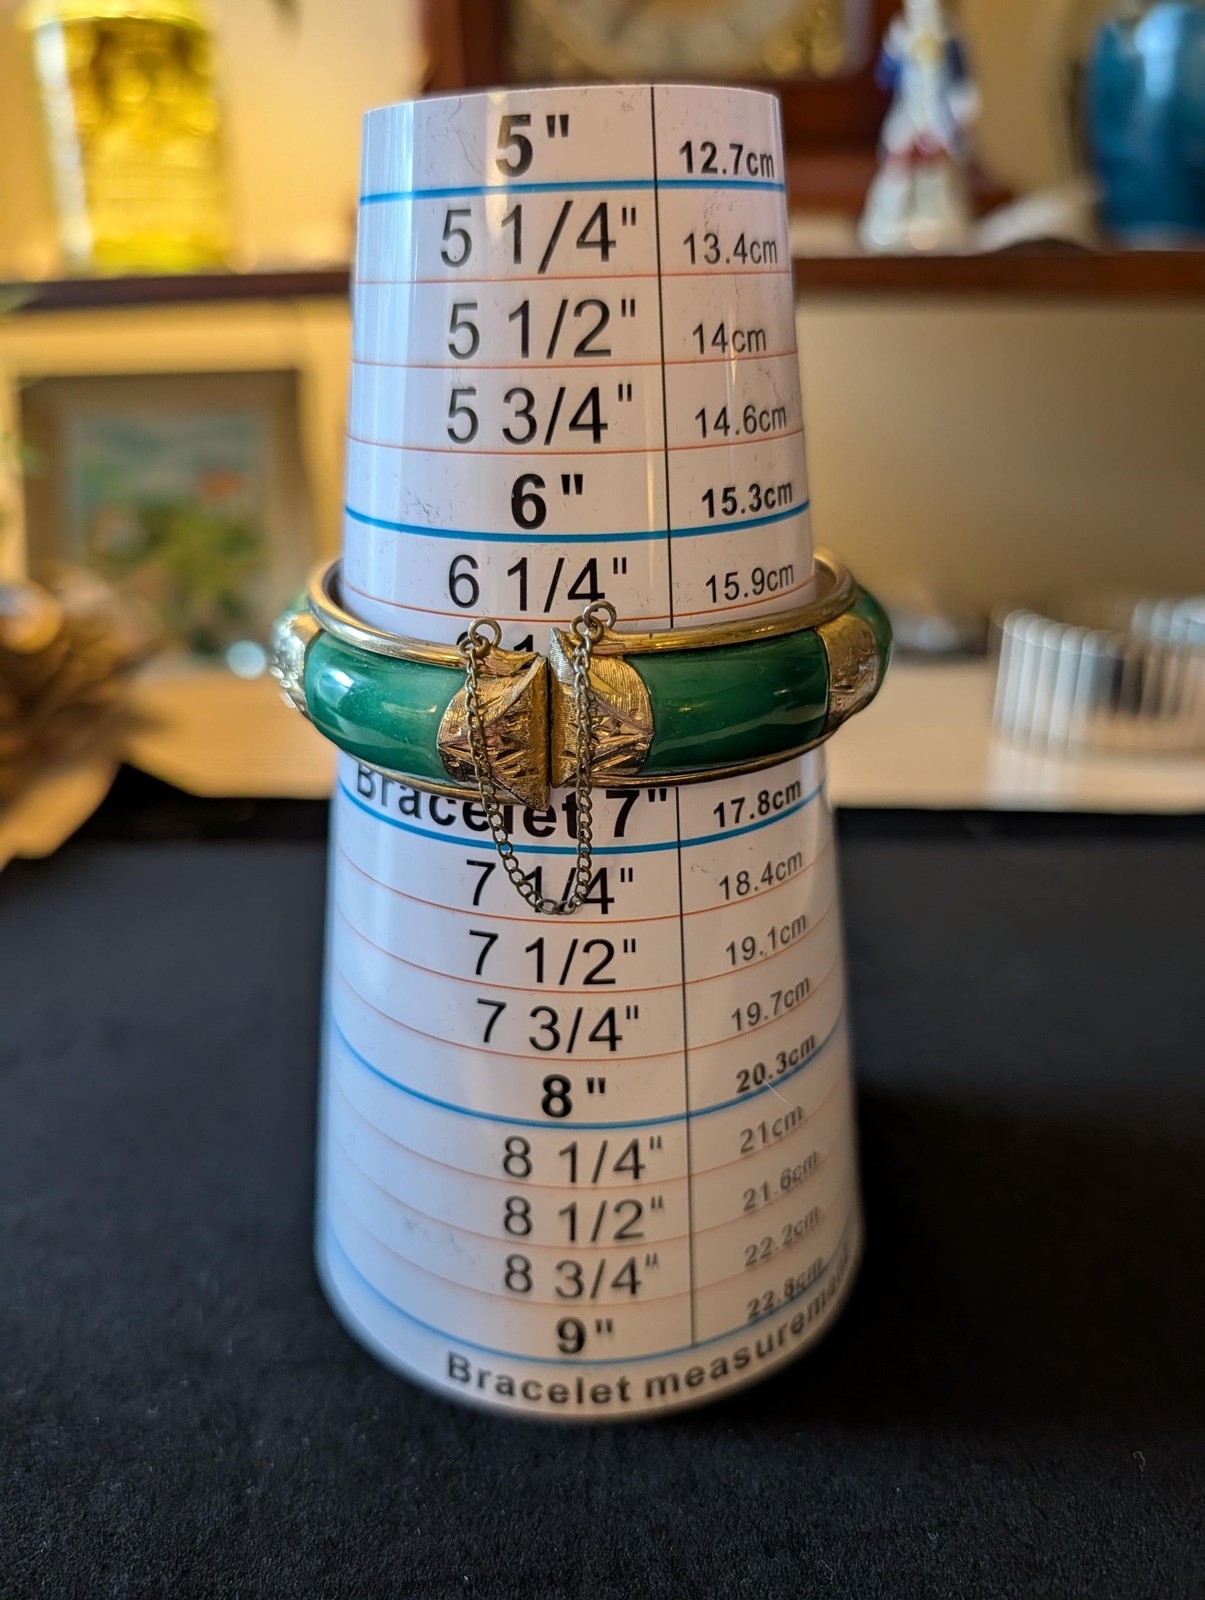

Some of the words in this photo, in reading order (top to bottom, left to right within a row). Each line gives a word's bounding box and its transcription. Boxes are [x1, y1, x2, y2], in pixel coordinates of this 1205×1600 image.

[678, 141, 775, 179] 12.7cm
[440, 208, 473, 269] 5
[682, 232, 778, 266] 13.4cm
[447, 302, 480, 361] 5
[692, 323, 767, 356] 14cm
[446, 387, 480, 446] 5
[694, 404, 788, 439] 14.6cm
[701, 480, 794, 520] 15.3cm
[447, 553, 481, 610] 6
[704, 561, 796, 605] 15.9cm
[712, 779, 802, 829] 17.8cm
[466, 859, 496, 906] 7
[718, 850, 803, 901] 18.4cm
[468, 929, 500, 977] 7
[725, 913, 807, 967] 19.1cm
[475, 998, 508, 1044] 7
[730, 976, 811, 1033] 19.7cm
[735, 1033, 816, 1095] 20.3cm
[739, 1104, 805, 1155] 21cm
[502, 1135, 534, 1180] 8
[742, 1150, 818, 1212] 21.6cm
[502, 1195, 534, 1238] 8
[743, 1205, 820, 1268] 22.2cm
[503, 1253, 534, 1295] 8
[446, 1350, 633, 1406] Bracelet
